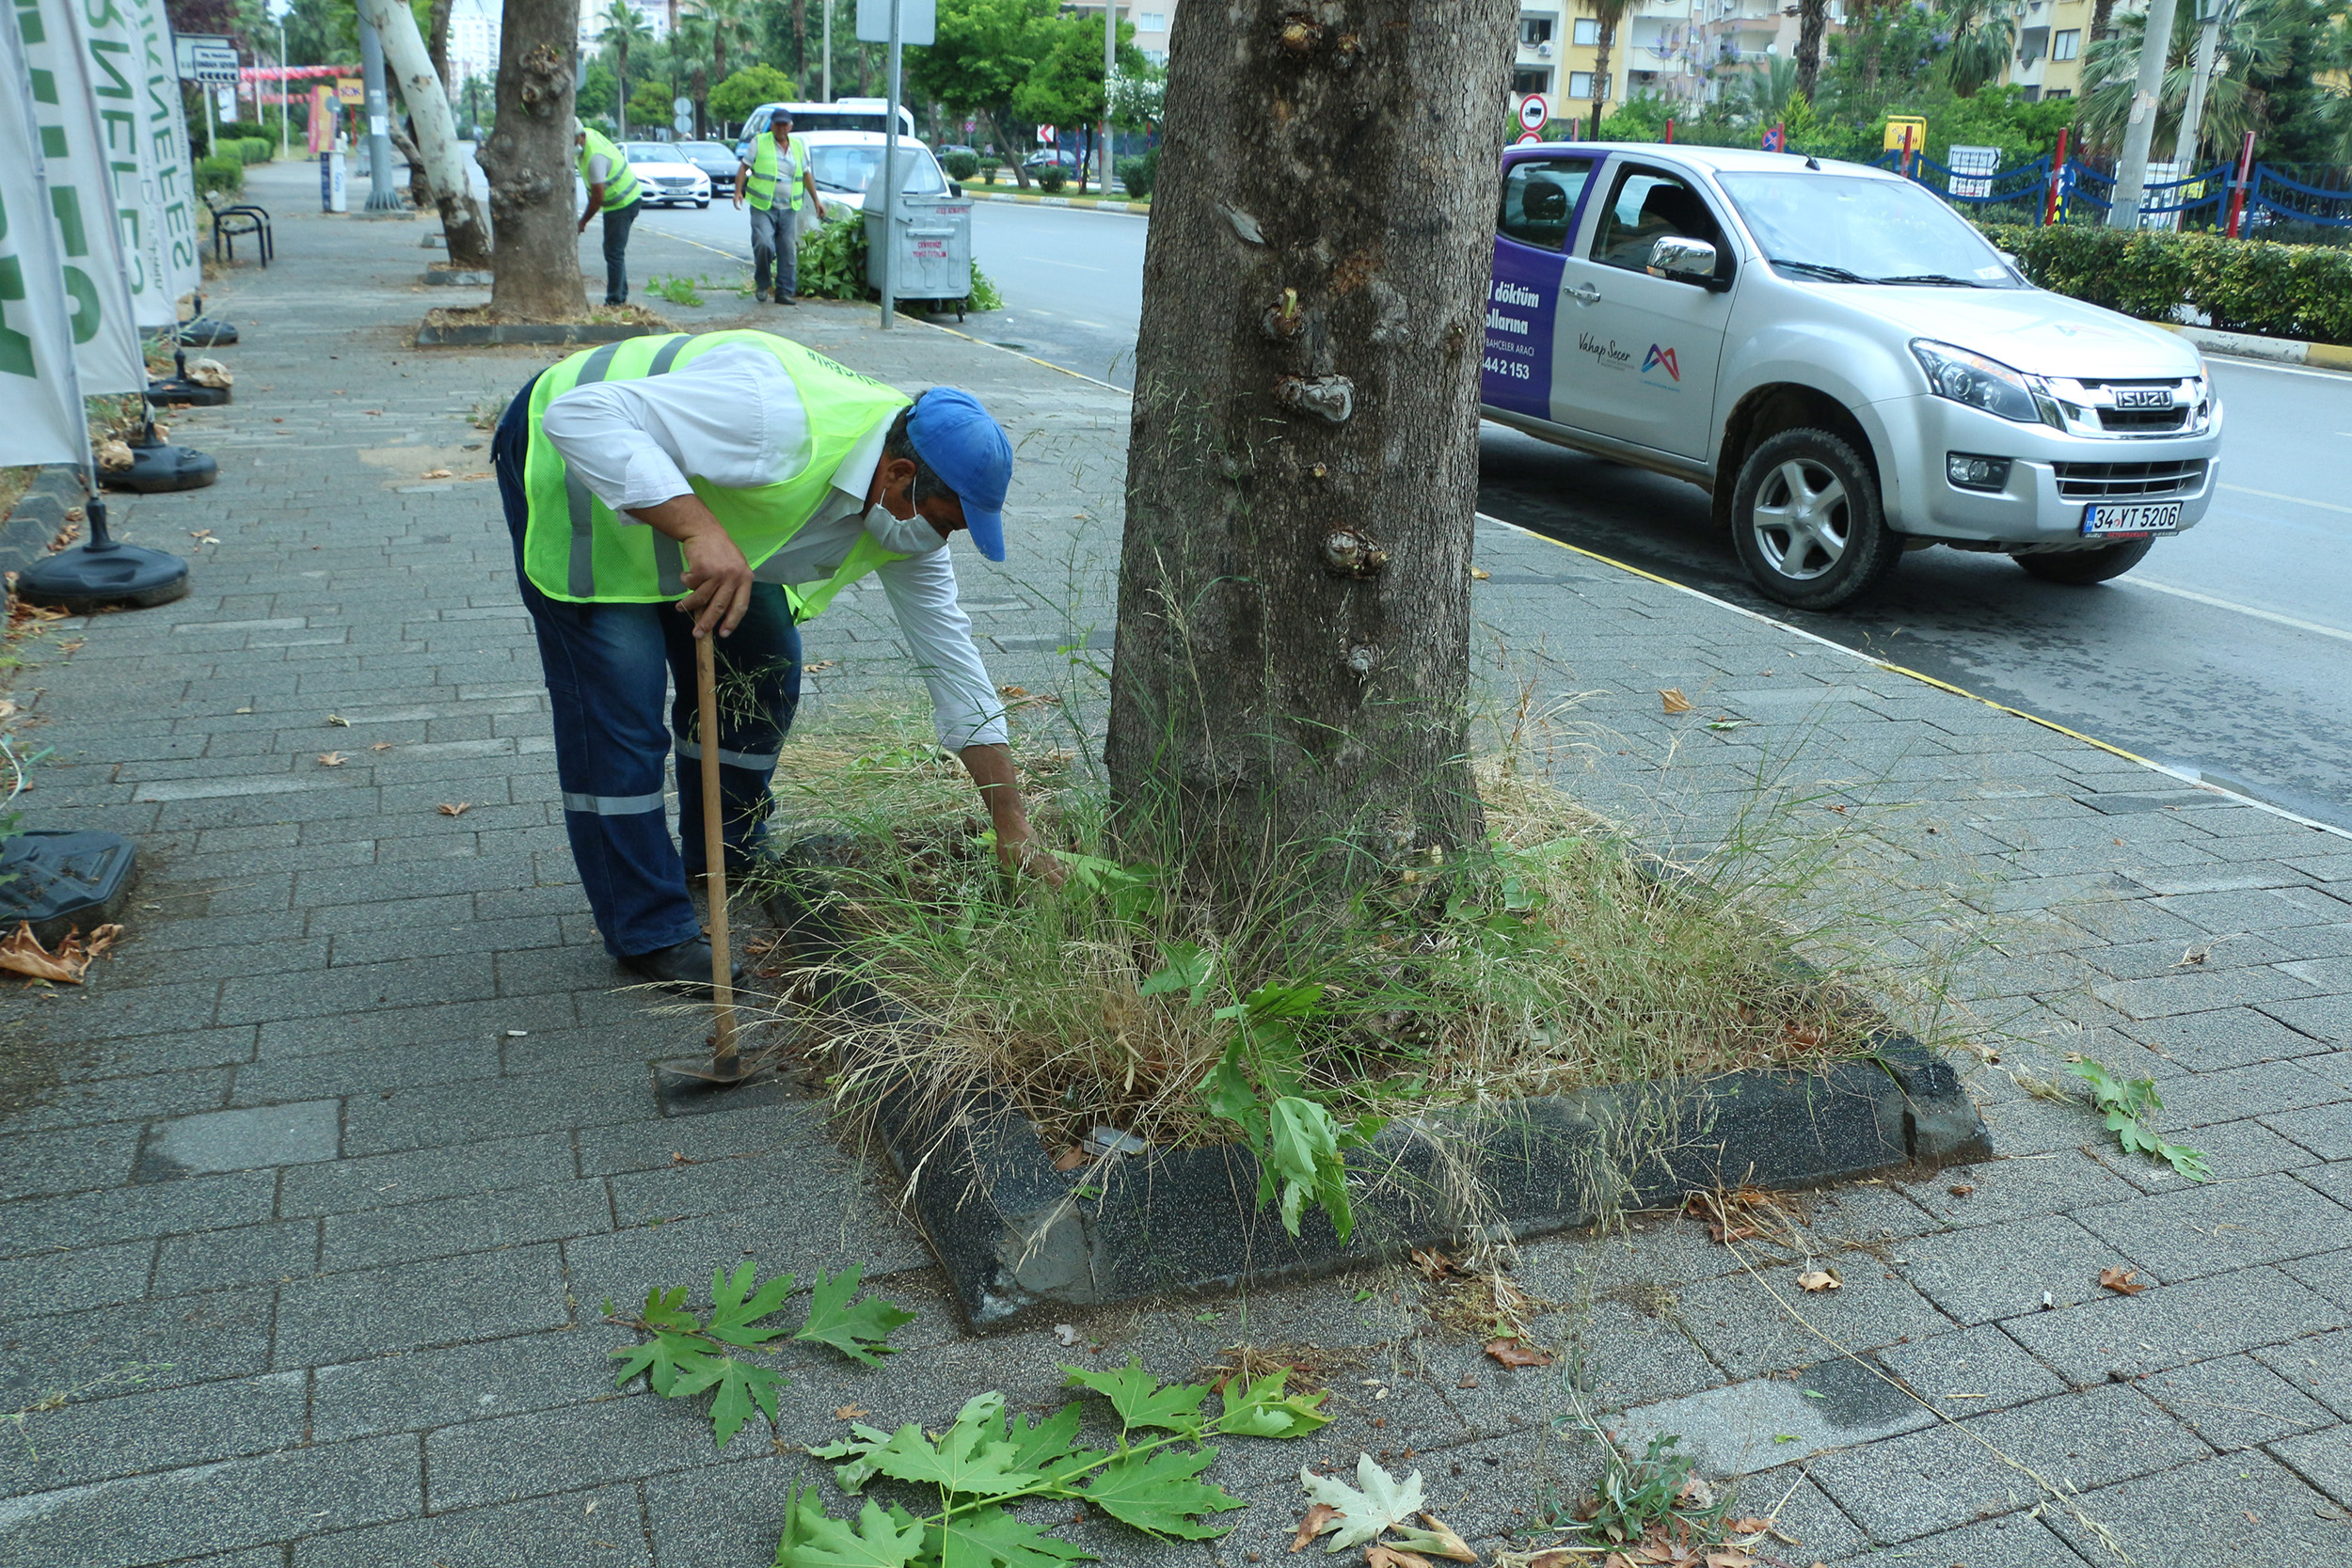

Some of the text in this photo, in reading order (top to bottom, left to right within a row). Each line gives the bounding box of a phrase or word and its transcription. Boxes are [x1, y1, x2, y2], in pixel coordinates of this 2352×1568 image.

[1495, 281, 1539, 308] döktüm
[1486, 308, 1529, 335] ollarına
[1486, 338, 1534, 357] BAHÇELER ARACI
[1579, 332, 1606, 364] Vahap
[1483, 356, 1530, 380] 44 2 153
[2117, 391, 2171, 406] ISUZU
[2094, 508, 2115, 530] 34
[2120, 508, 2139, 529] YT
[2139, 506, 2178, 528] 5206
